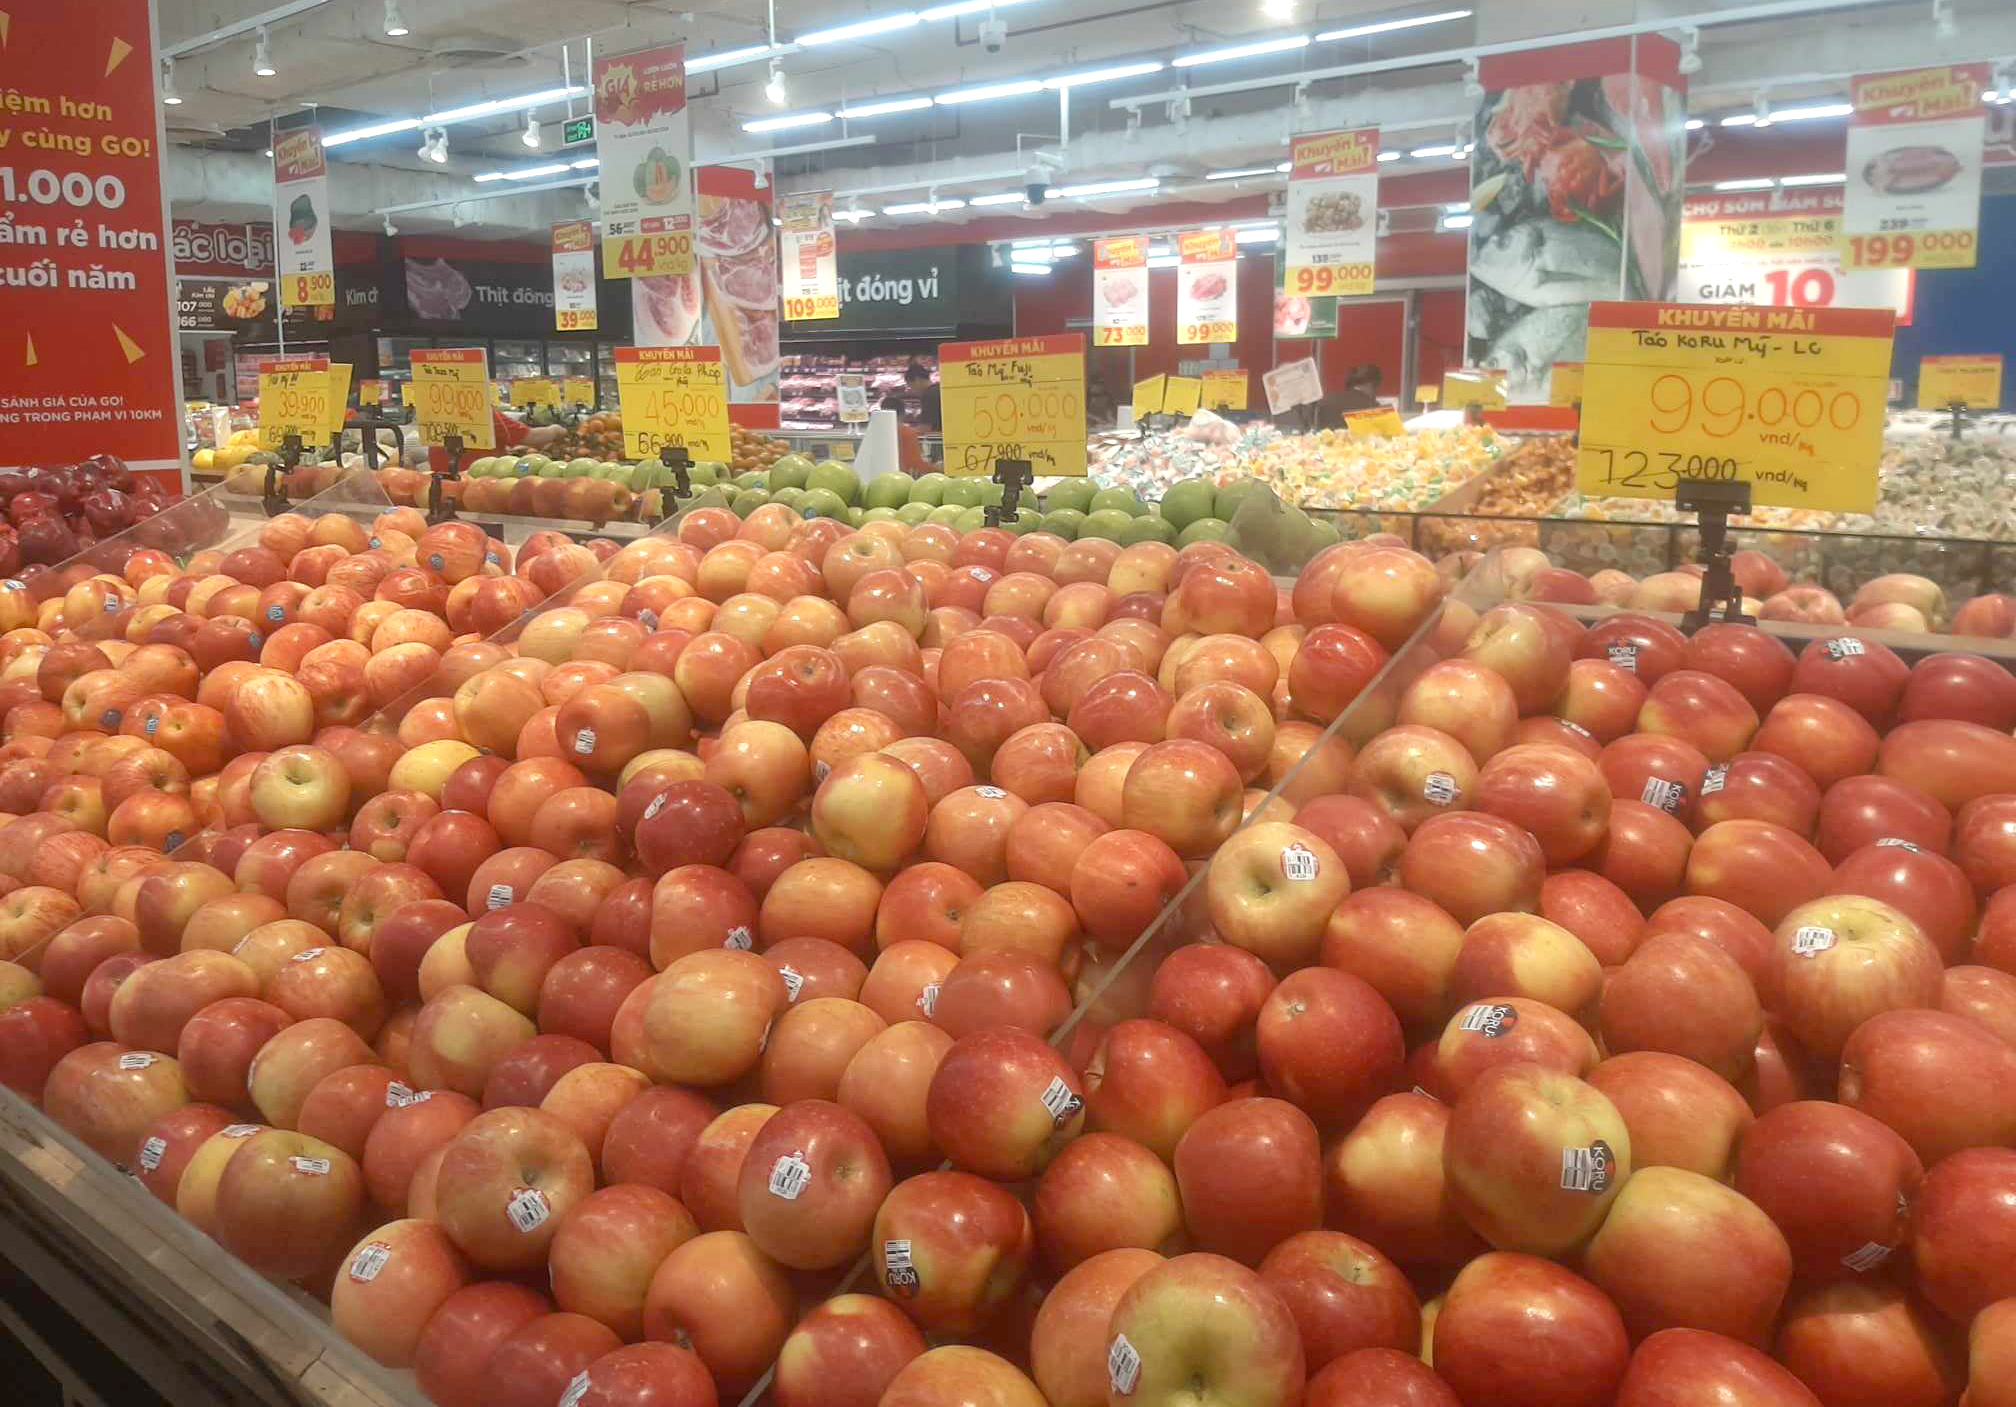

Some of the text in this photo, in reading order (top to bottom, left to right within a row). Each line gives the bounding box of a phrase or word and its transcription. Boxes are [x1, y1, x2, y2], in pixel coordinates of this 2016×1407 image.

[60, 95, 112, 121] hơn
[22, 127, 91, 156] cùng
[100, 134, 150, 158] GO!
[0, 166, 125, 209] 1.000
[56, 219, 89, 247] rẻ
[98, 224, 157, 250] hơn
[68, 263, 136, 290] năm
[476, 286, 510, 306] Thịt
[1658, 306, 1816, 331] KHUYẾN MÃI
[1, 393, 124, 408] SÁNH GIÁ CỦA GO!
[645, 391, 720, 427] 45.000
[1650, 374, 1861, 438] 99.000
[23, 411, 71, 423] TRONG
[114, 410, 127, 421] VI
[129, 410, 162, 421] 10KM
[974, 394, 1077, 440] 59.000
[1608, 646, 1637, 657] KORU
[1663, 783, 1684, 814] KORU
[1485, 1006, 1508, 1035] KORU
[1592, 1146, 1606, 1190] KORU
